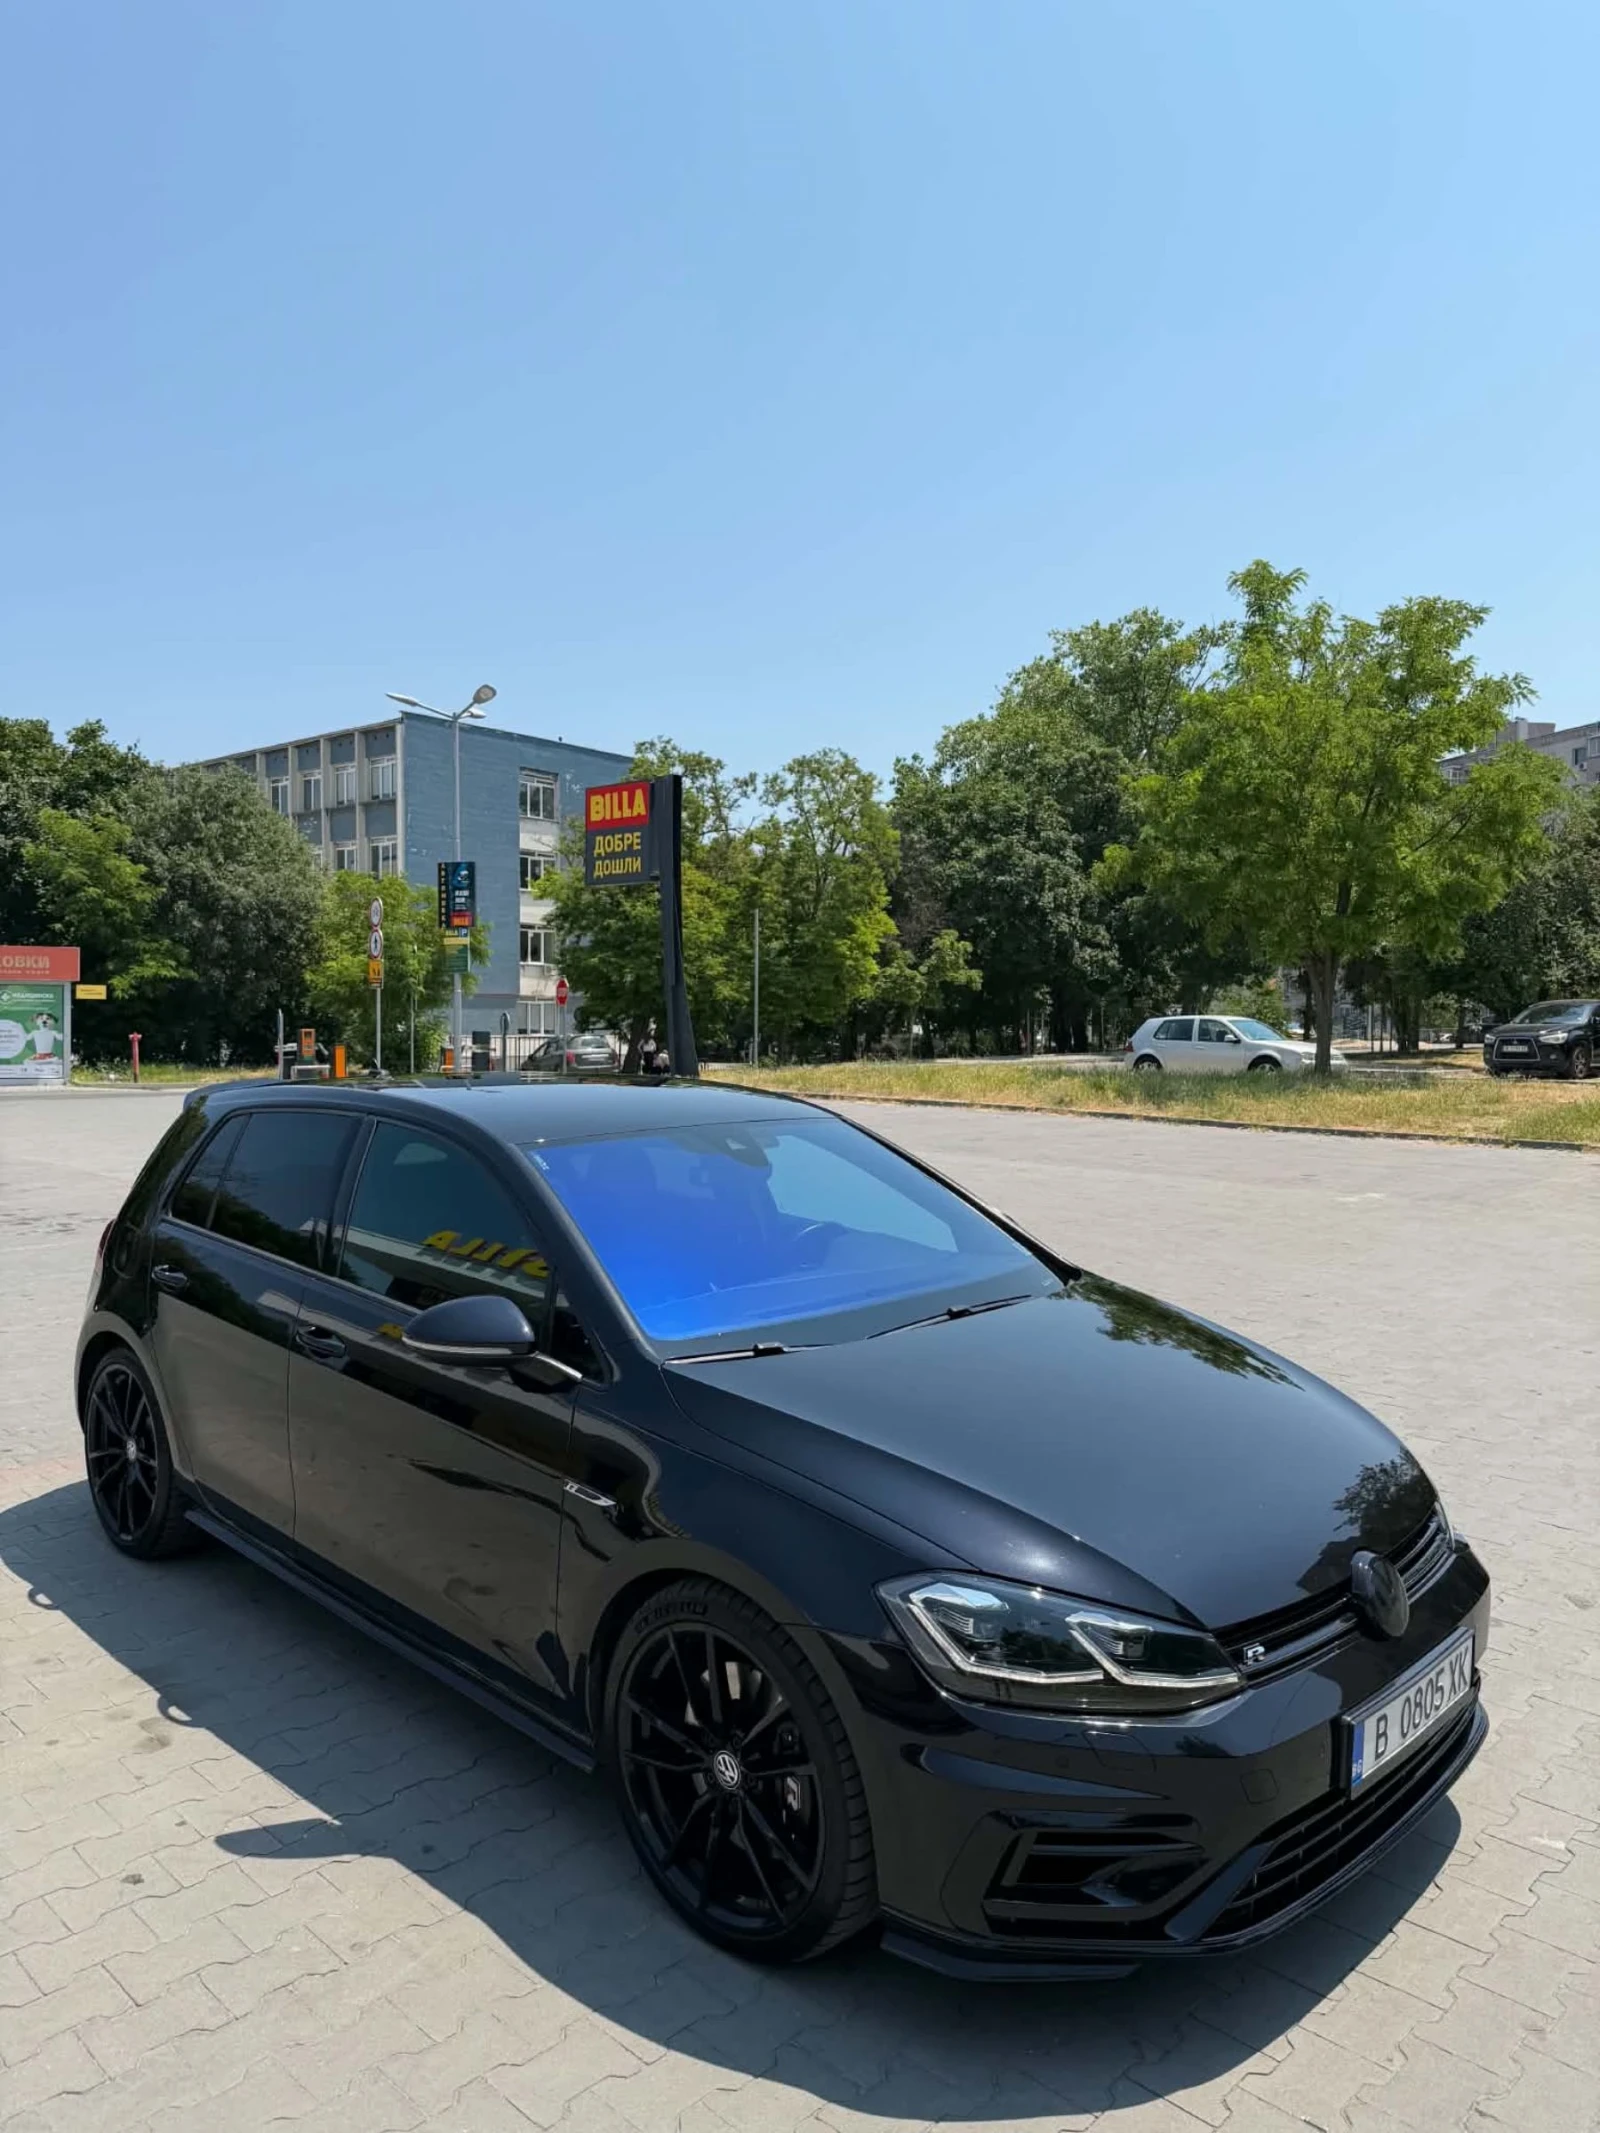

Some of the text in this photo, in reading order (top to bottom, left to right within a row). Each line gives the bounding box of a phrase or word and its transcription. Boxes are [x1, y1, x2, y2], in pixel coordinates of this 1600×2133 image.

[590, 788, 646, 822] BILLA
[594, 831, 642, 857] ДОБРЕ
[594, 856, 642, 879] ДОШЛИ
[0, 955, 50, 969] ОВКИ
[1374, 1646, 1469, 1762] B 0805 XK
